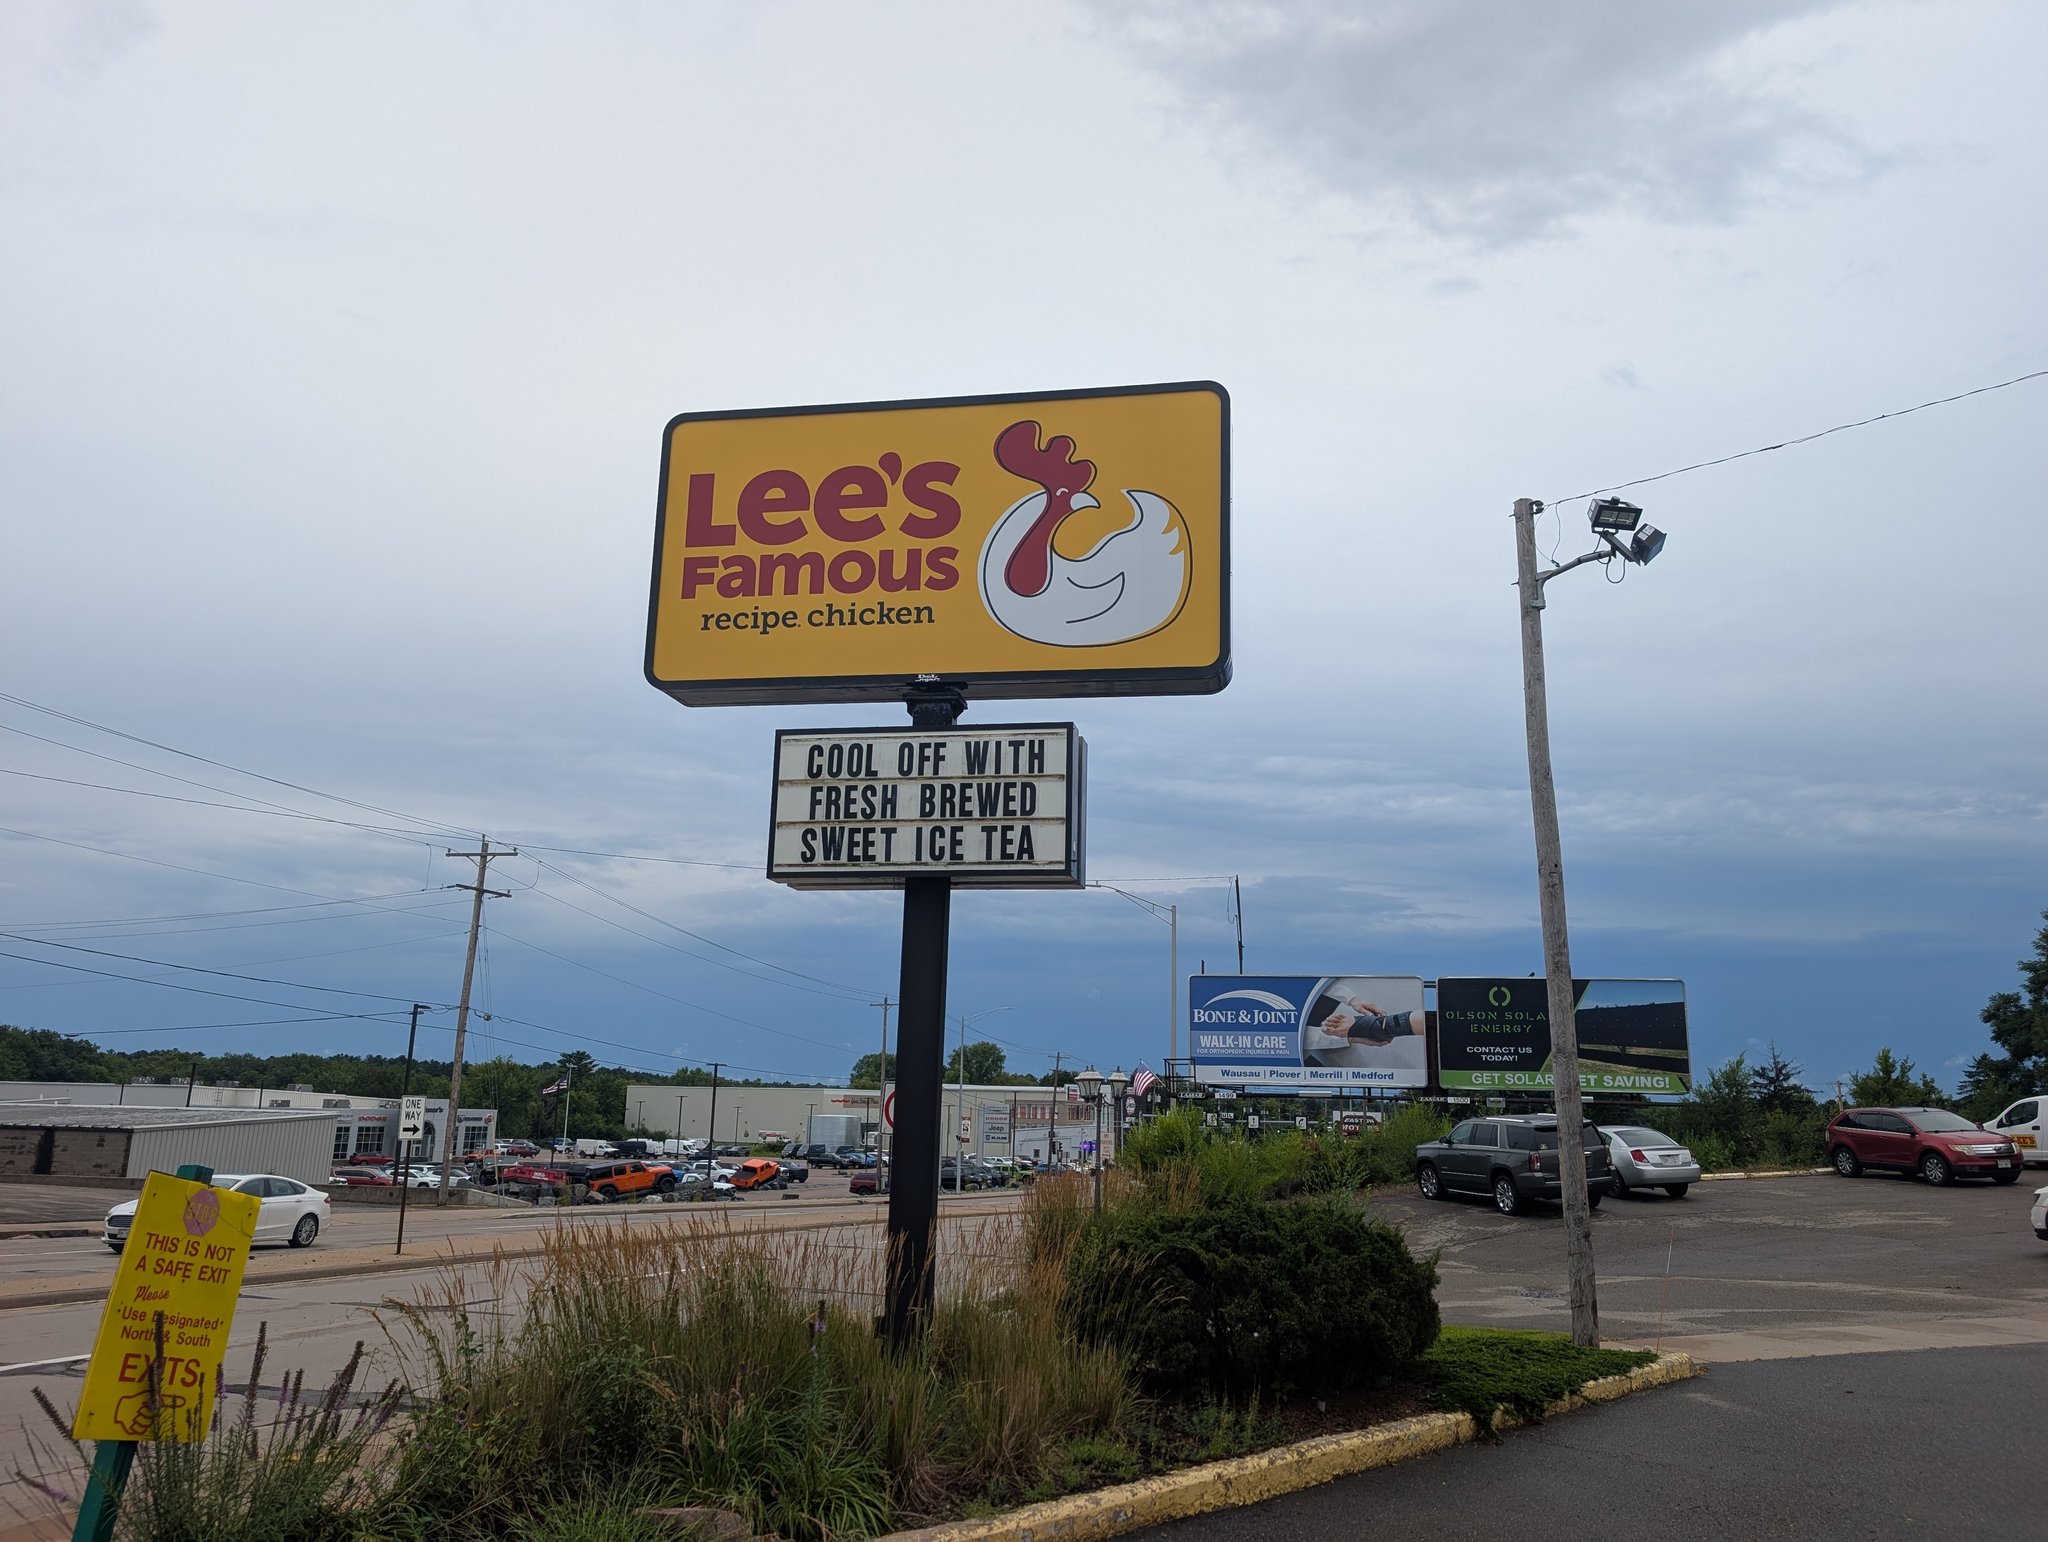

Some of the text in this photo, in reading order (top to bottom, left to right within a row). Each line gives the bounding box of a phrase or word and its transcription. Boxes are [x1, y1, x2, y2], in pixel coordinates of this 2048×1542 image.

[685, 452, 961, 547] Lee's
[681, 546, 960, 599] Famous
[807, 602, 935, 627] chicken
[807, 740, 1045, 779] COOL OFF WITH
[809, 782, 1037, 820] FRESH BREWED
[800, 825, 1034, 863] SWEET ICE TEA
[1193, 1009, 1298, 1025] BONE & JOINT
[1446, 1011, 1546, 1021] OLSON SOLA
[1471, 1024, 1532, 1033] ENERGY
[1200, 1035, 1287, 1049] WALK-IN CARE
[1221, 1069, 1394, 1080] Wausau Plover Merrill Medford
[1472, 1073, 1670, 1088] GET SOLAR ET SAVING!
[405, 1099, 421, 1109] ONE
[404, 1110, 422, 1121] WAY
[185, 1203, 218, 1220] STOP
[146, 1232, 180, 1253] THIS
[184, 1240, 200, 1257] IS
[204, 1244, 235, 1263] NOT
[135, 1255, 231, 1284] A SAFE EXIT
[134, 1284, 170, 1302] Please
[122, 1306, 147, 1321] Use
[121, 1326, 157, 1342] North
[176, 1332, 211, 1347] South
